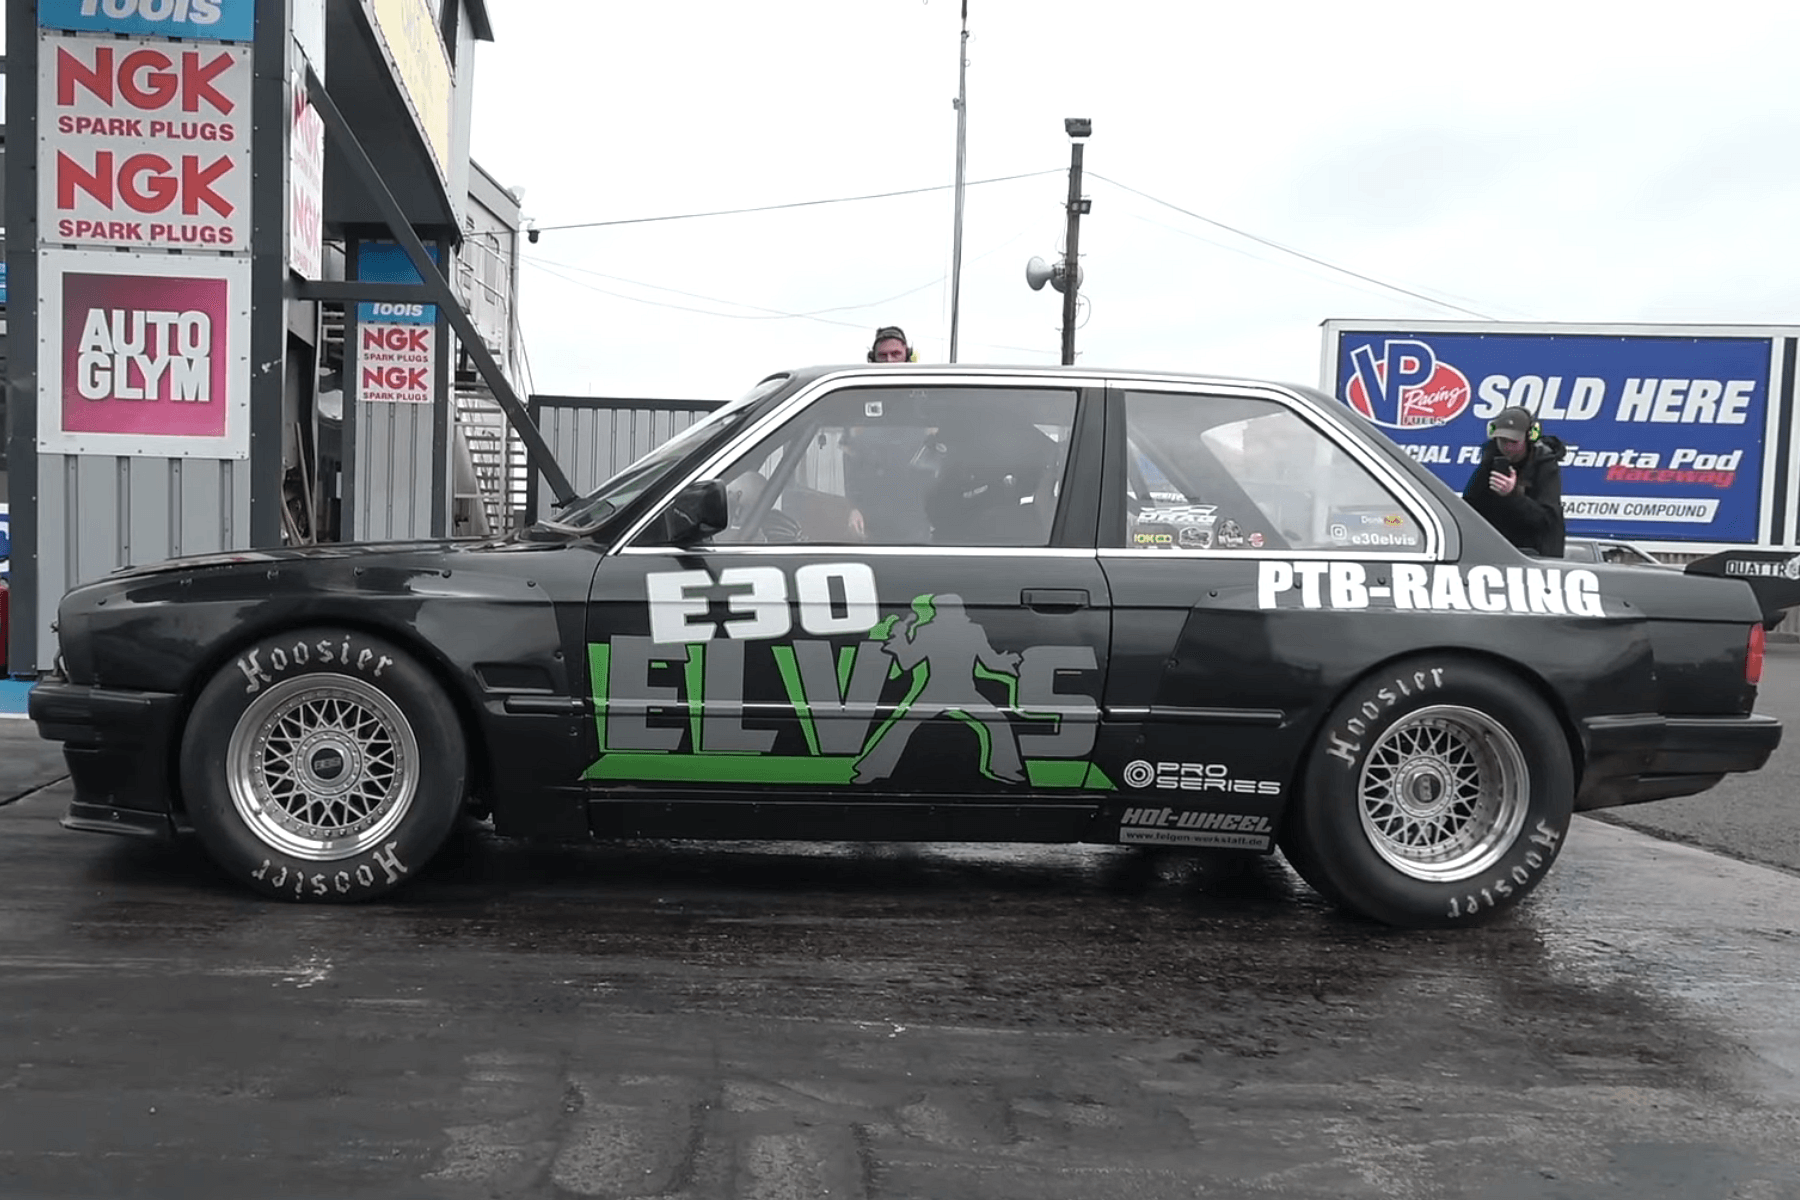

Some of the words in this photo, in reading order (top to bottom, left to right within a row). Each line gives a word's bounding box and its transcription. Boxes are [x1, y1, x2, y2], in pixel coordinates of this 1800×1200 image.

[57, 46, 235, 117] NGK
[58, 116, 142, 137] SPARK
[149, 121, 235, 142] PLUGS
[57, 149, 235, 220] NGK
[58, 219, 142, 241] SPARK
[149, 224, 234, 244] PLUGS
[78, 307, 211, 358] AUTO
[363, 327, 429, 352] NGK
[77, 352, 210, 402] GLYM
[363, 353, 394, 361] SPARK
[396, 354, 429, 363] PLUGS
[362, 366, 428, 391] NGK
[362, 391, 394, 400] SPARK
[396, 393, 428, 401] PLUGS
[1350, 339, 1436, 425] VP
[1403, 385, 1460, 415] Racing
[1473, 375, 1606, 421] SOLD
[1615, 378, 1756, 424] HERE
[1668, 448, 1743, 471] Pod
[1623, 503, 1707, 518] COMPOUND
[1352, 533, 1417, 546] e30elvis
[645, 562, 879, 645] E30
[1258, 560, 1606, 618] PTB-RACING
[237, 635, 394, 694] Hoosier
[1326, 667, 1444, 769] Hoosier
[1156, 761, 1228, 777] PRO
[1156, 776, 1281, 795] SERIES
[251, 840, 408, 899] Hoosier
[1447, 818, 1560, 918] Hoosier
